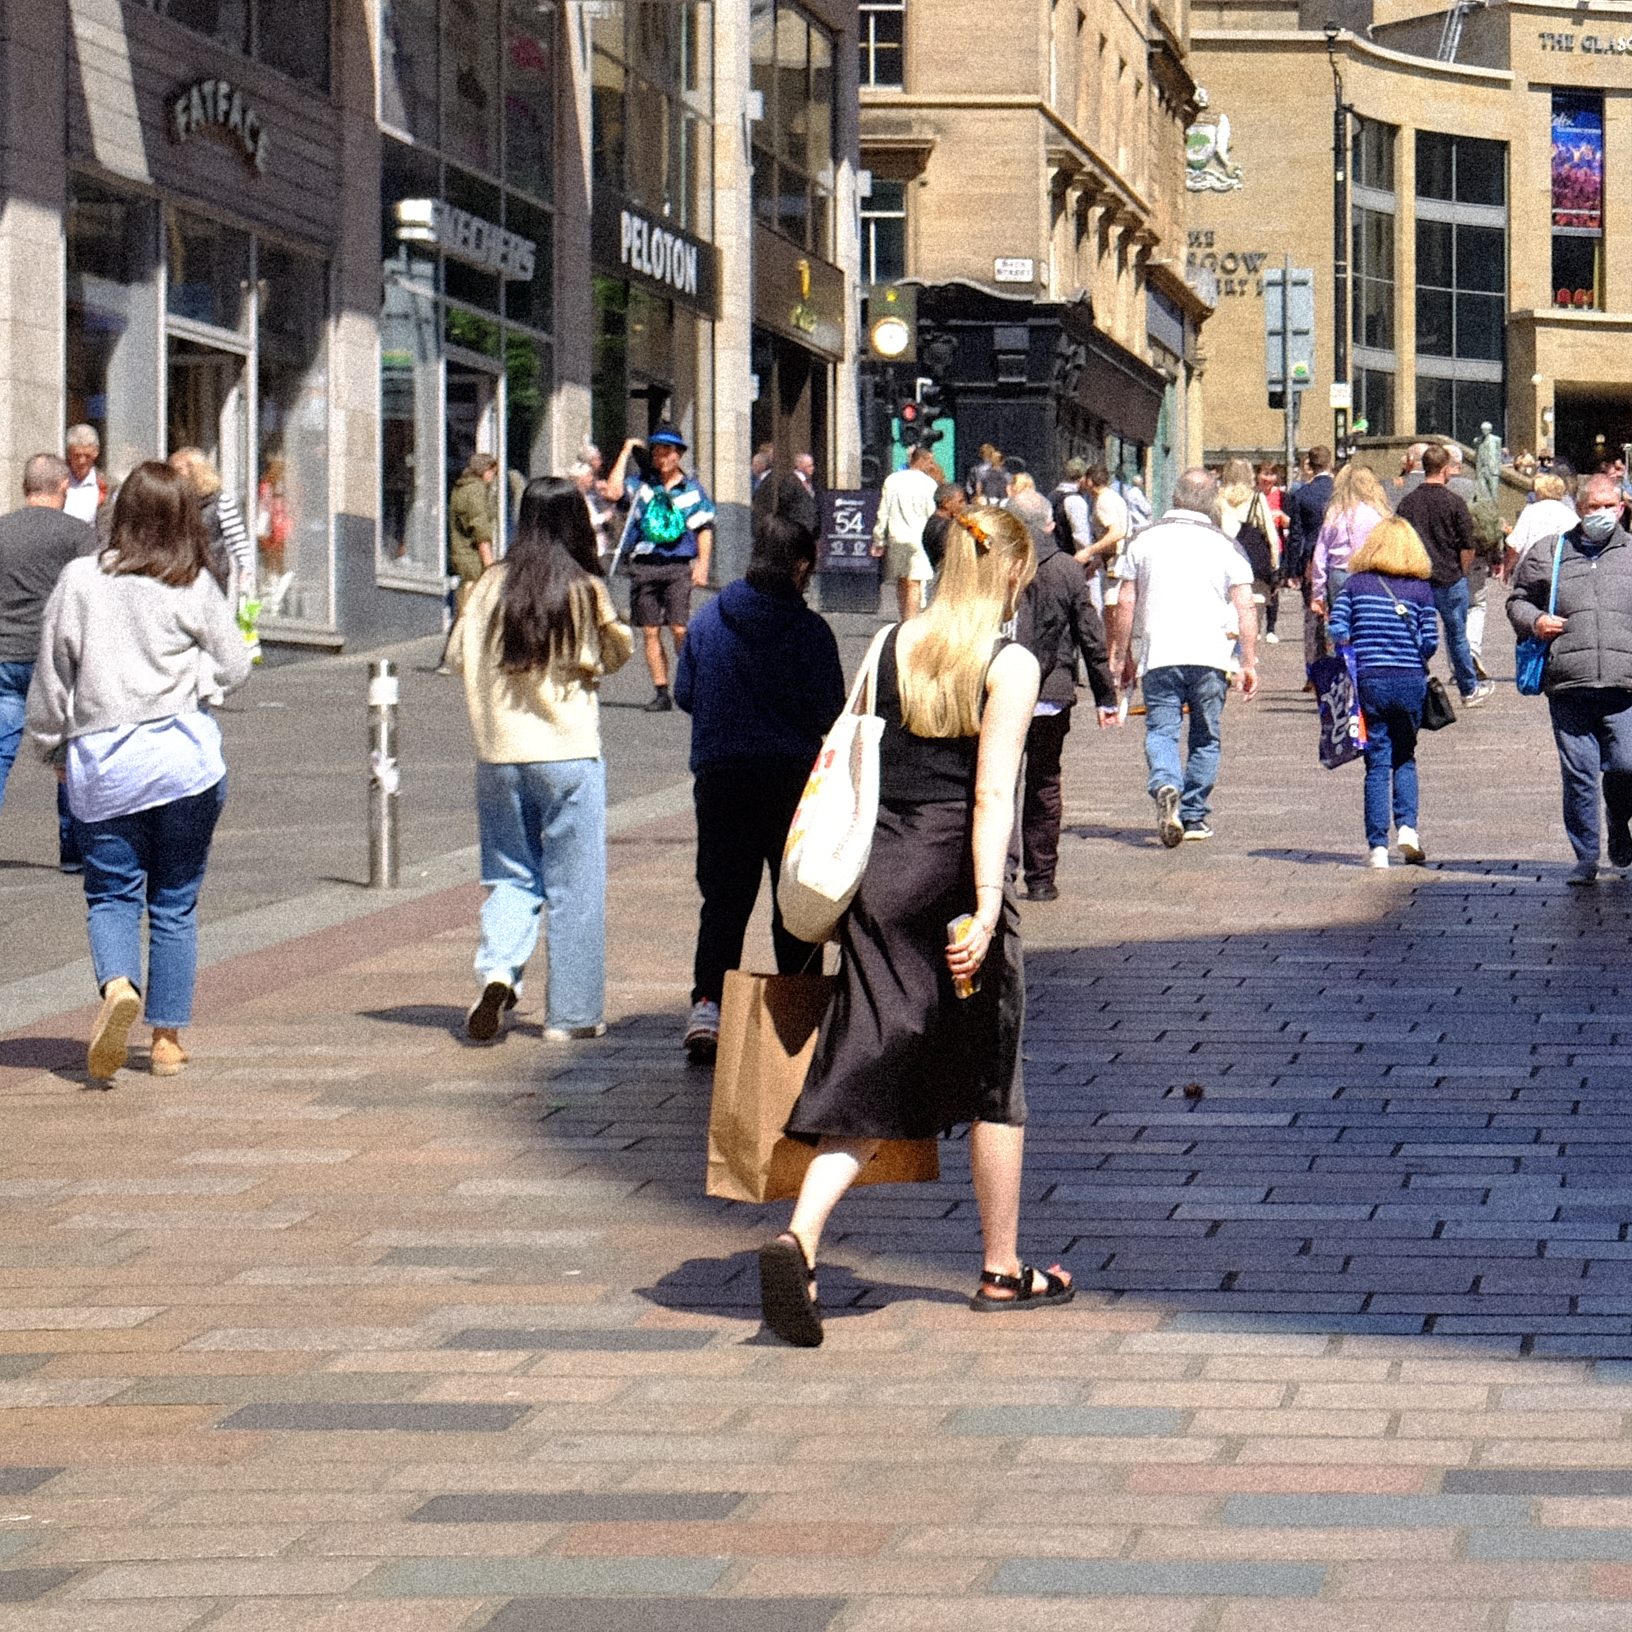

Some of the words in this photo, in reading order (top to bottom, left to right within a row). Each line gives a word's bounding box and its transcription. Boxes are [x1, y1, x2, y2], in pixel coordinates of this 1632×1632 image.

[1539, 32, 1574, 51] THE
[174, 79, 270, 174] FATFACE
[620, 210, 698, 296] PELOTON
[831, 510, 864, 535] 54
